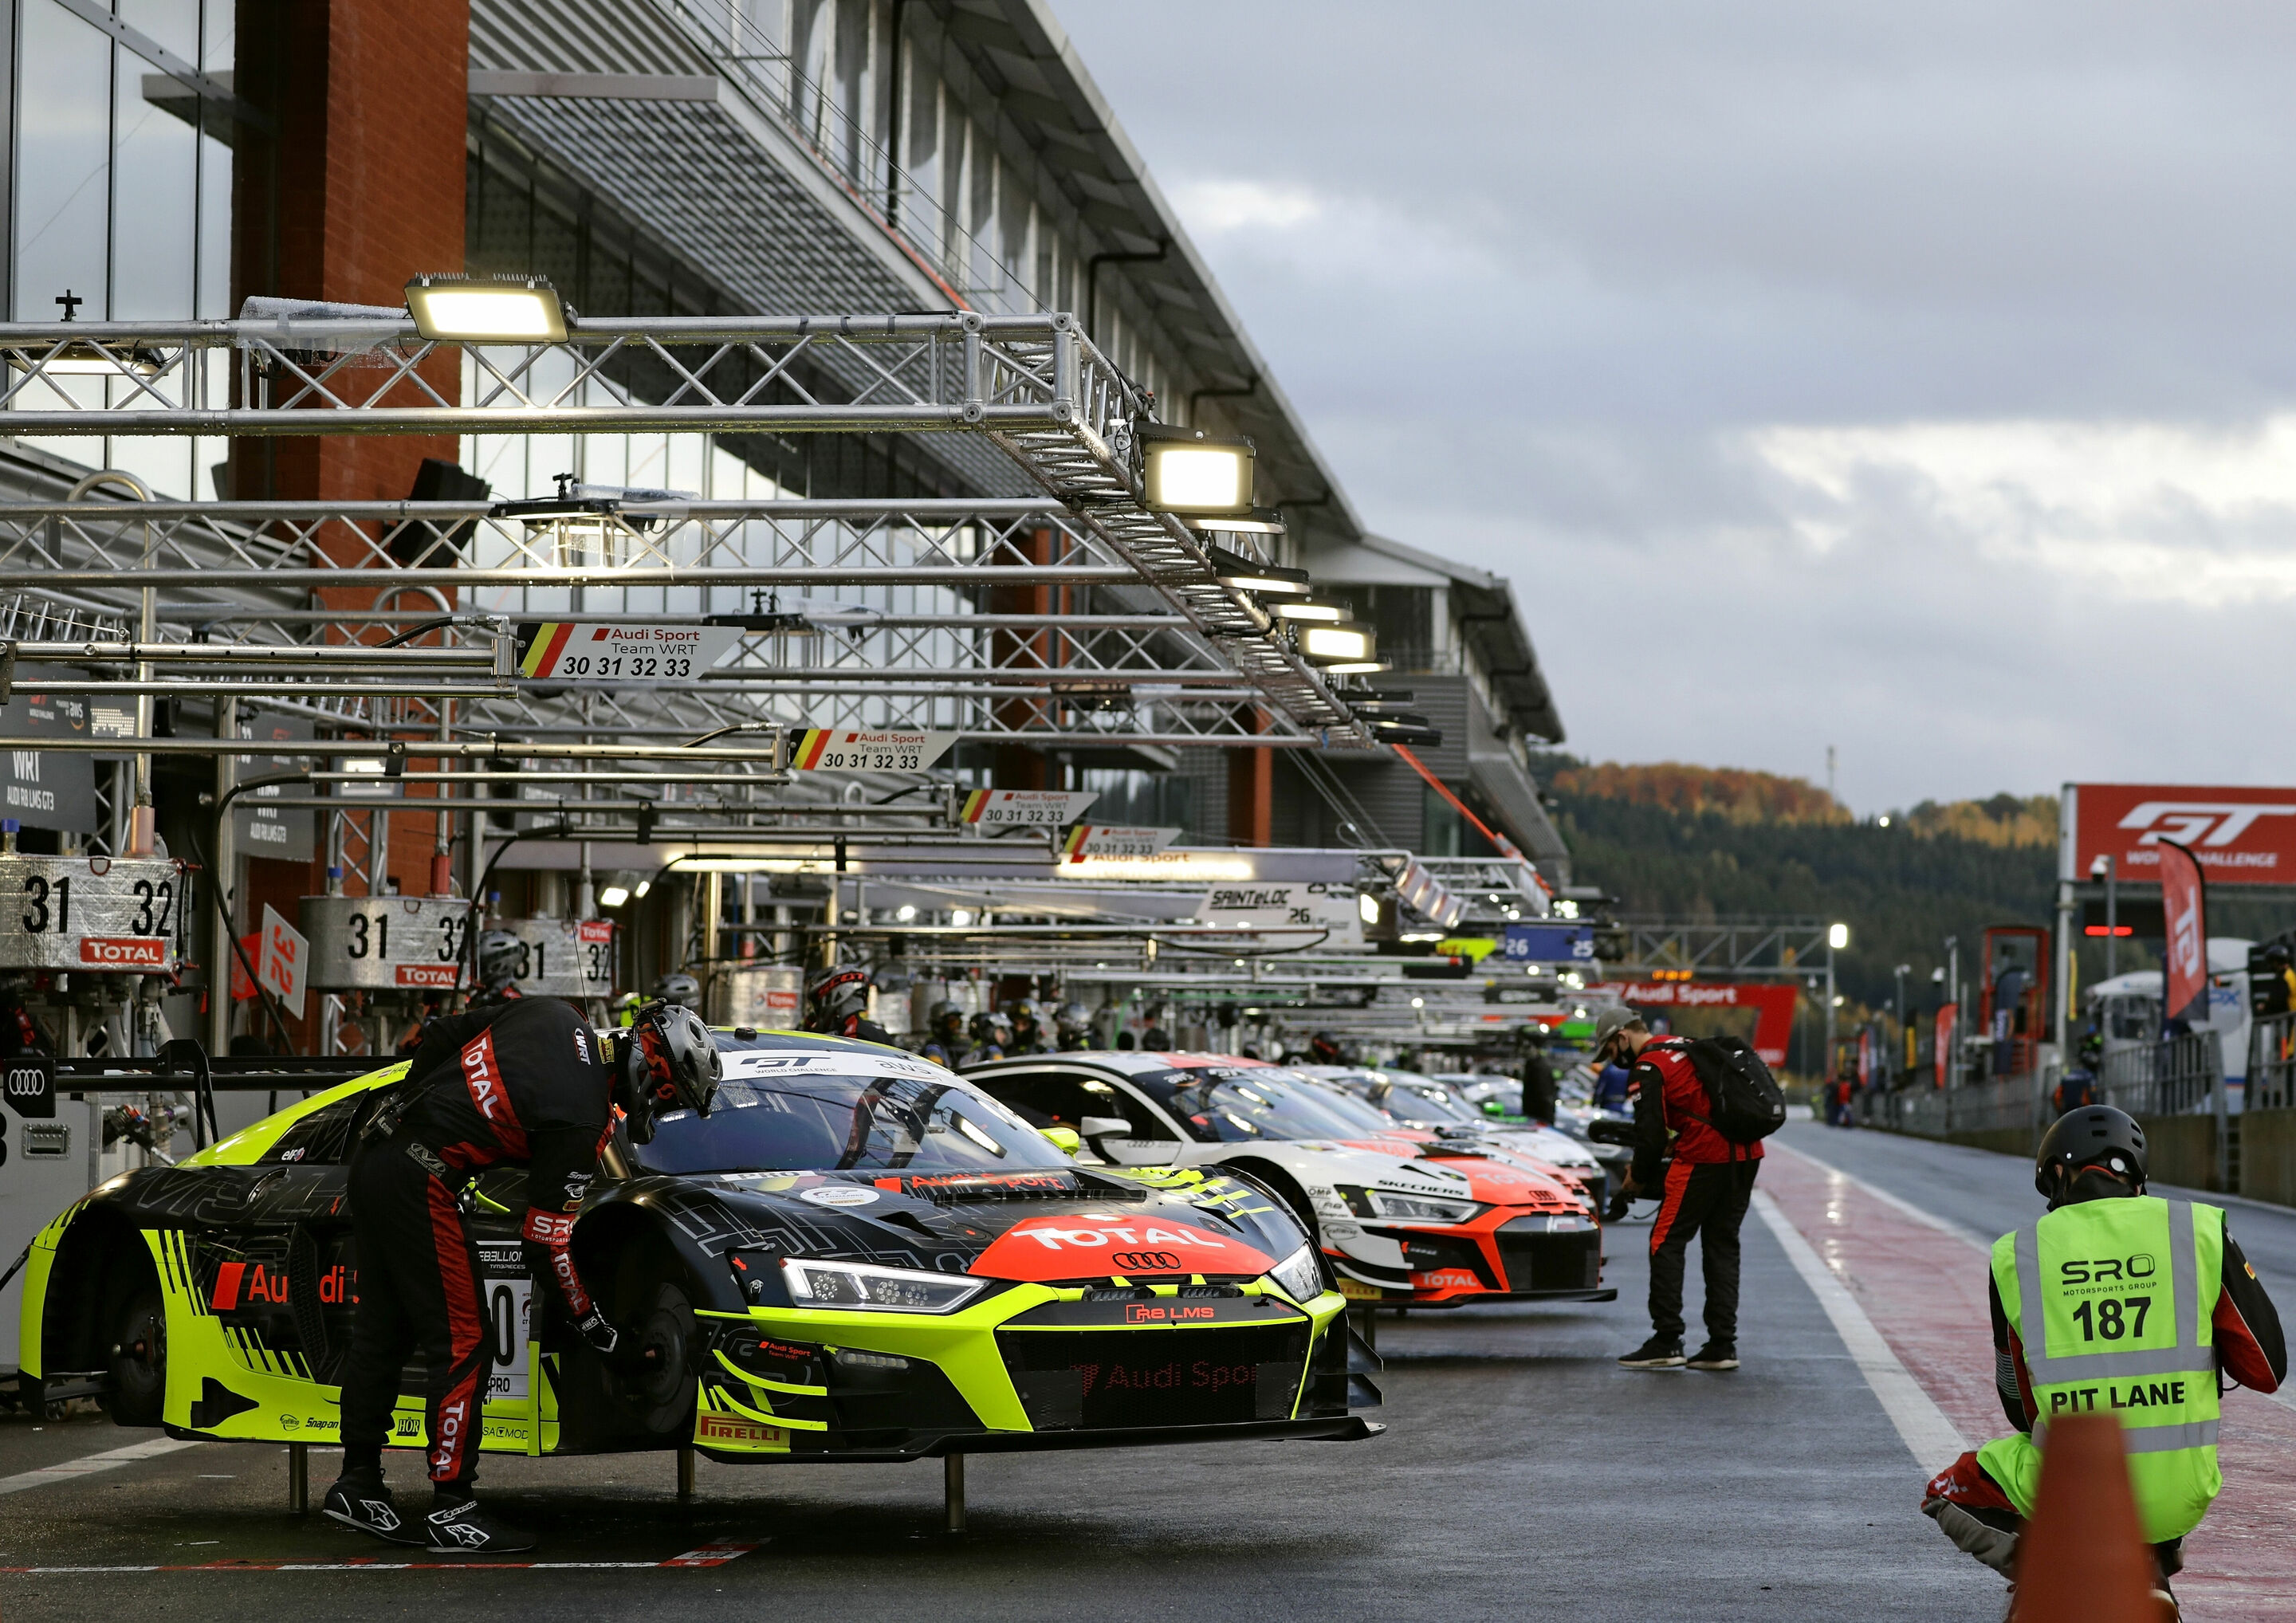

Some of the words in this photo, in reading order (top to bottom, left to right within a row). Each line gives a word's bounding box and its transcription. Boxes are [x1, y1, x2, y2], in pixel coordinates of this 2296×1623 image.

[611, 628, 649, 640] Audi
[654, 629, 700, 643] Sport
[611, 643, 654, 654] Team
[659, 644, 698, 655] WRT
[563, 656, 590, 675] 30
[596, 657, 623, 676] 31
[630, 658, 657, 676] 32
[663, 658, 690, 677] 33
[859, 733, 887, 743] Audi
[891, 734, 925, 745] Sport
[859, 744, 891, 753] Team
[895, 745, 923, 754] WRT
[13, 751, 41, 782] WRT
[824, 753, 843, 768] 30
[849, 754, 868, 768] 31
[874, 755, 893, 768] 32
[898, 756, 918, 769] 33
[7, 785, 20, 805] AUDI
[29, 791, 41, 809] LMS
[42, 793, 54, 812] GT3
[1015, 792, 1038, 801] Audi
[1041, 793, 1069, 802] Sport
[985, 809, 1002, 821] 30
[1006, 810, 1022, 821] 31
[1027, 811, 1044, 822] 32
[1048, 811, 1063, 822] 33
[1086, 843, 1101, 854] 30
[1103, 843, 1118, 854] 31
[1121, 843, 1136, 855] 32
[1139, 844, 1154, 855] 33
[2196, 851, 2278, 867] HALLENGE
[23, 875, 70, 933] 31
[132, 879, 173, 937] 32
[1290, 908, 1310, 923] 26
[348, 913, 388, 958] 31
[582, 926, 611, 939] TOTAL
[88, 941, 159, 961] TOTAL
[1506, 939, 1528, 955] 26
[1572, 940, 1594, 957] 25
[514, 941, 545, 980] 31
[587, 944, 609, 982] 32
[402, 967, 456, 983] TOTAL
[1626, 984, 1673, 1002] Audi
[1677, 984, 1736, 1005] Sport
[875, 1059, 931, 1075] aws
[465, 1037, 498, 1119] TOTAL
[738, 1171, 796, 1180] PRO
[912, 1173, 976, 1189] Audi
[981, 1173, 1065, 1189] Sport
[1378, 1180, 1464, 1197] SKECHERS
[533, 1215, 575, 1236] SR
[1012, 1227, 1225, 1250] TOTAL
[2061, 1252, 2156, 1285] SRO
[248, 1263, 345, 1303] Audi
[555, 1252, 583, 1311] TOTAL
[1421, 1271, 1479, 1287] TOTAL
[2063, 1285, 2125, 1297] MOTORSPORTS
[2128, 1281, 2157, 1291] GROUP
[1170, 1307, 1215, 1319] LMS
[2073, 1296, 2151, 1342] 187
[769, 1343, 786, 1352] Audi
[788, 1346, 812, 1357] Sport
[1105, 1362, 1181, 1391] Audi
[2050, 1388, 2099, 1414] PIT
[2110, 1381, 2185, 1409] LANE
[305, 1417, 339, 1430] Snap-on
[399, 1417, 420, 1433] HÖR
[701, 1416, 780, 1442] PIRELLI
[436, 1401, 465, 1479] TOTAL
